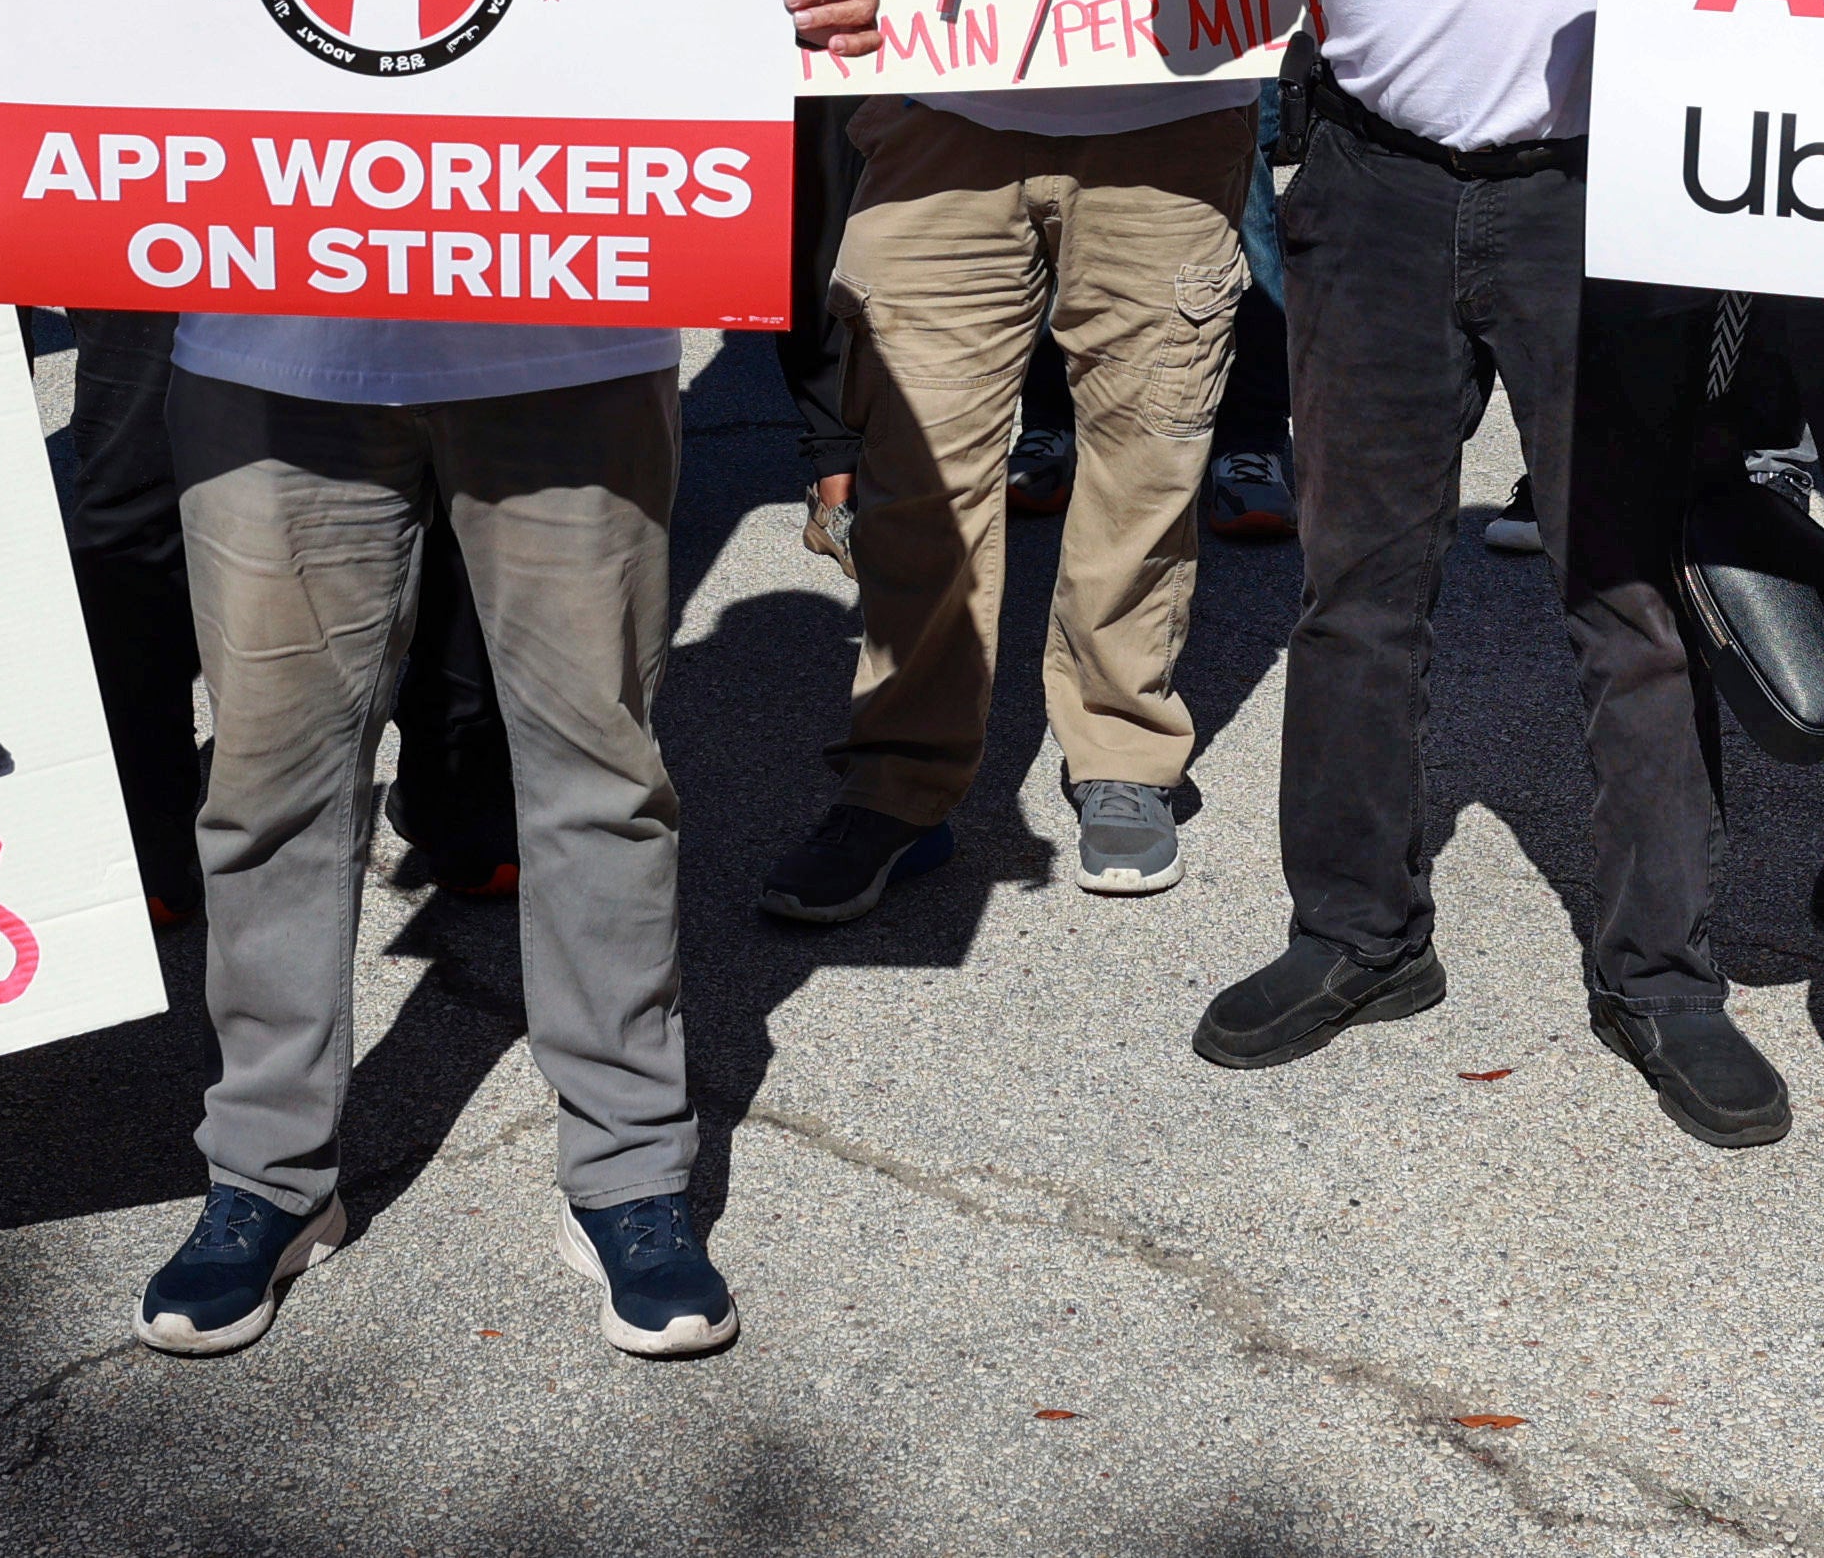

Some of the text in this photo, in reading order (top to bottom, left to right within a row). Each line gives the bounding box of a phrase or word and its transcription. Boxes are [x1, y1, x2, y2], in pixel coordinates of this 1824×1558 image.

[296, 26, 356, 63] ADOLAT
[379, 54, 426, 71] 정당성
[22, 130, 753, 220] APP WORKERS
[126, 222, 651, 303] ON STRIKE
